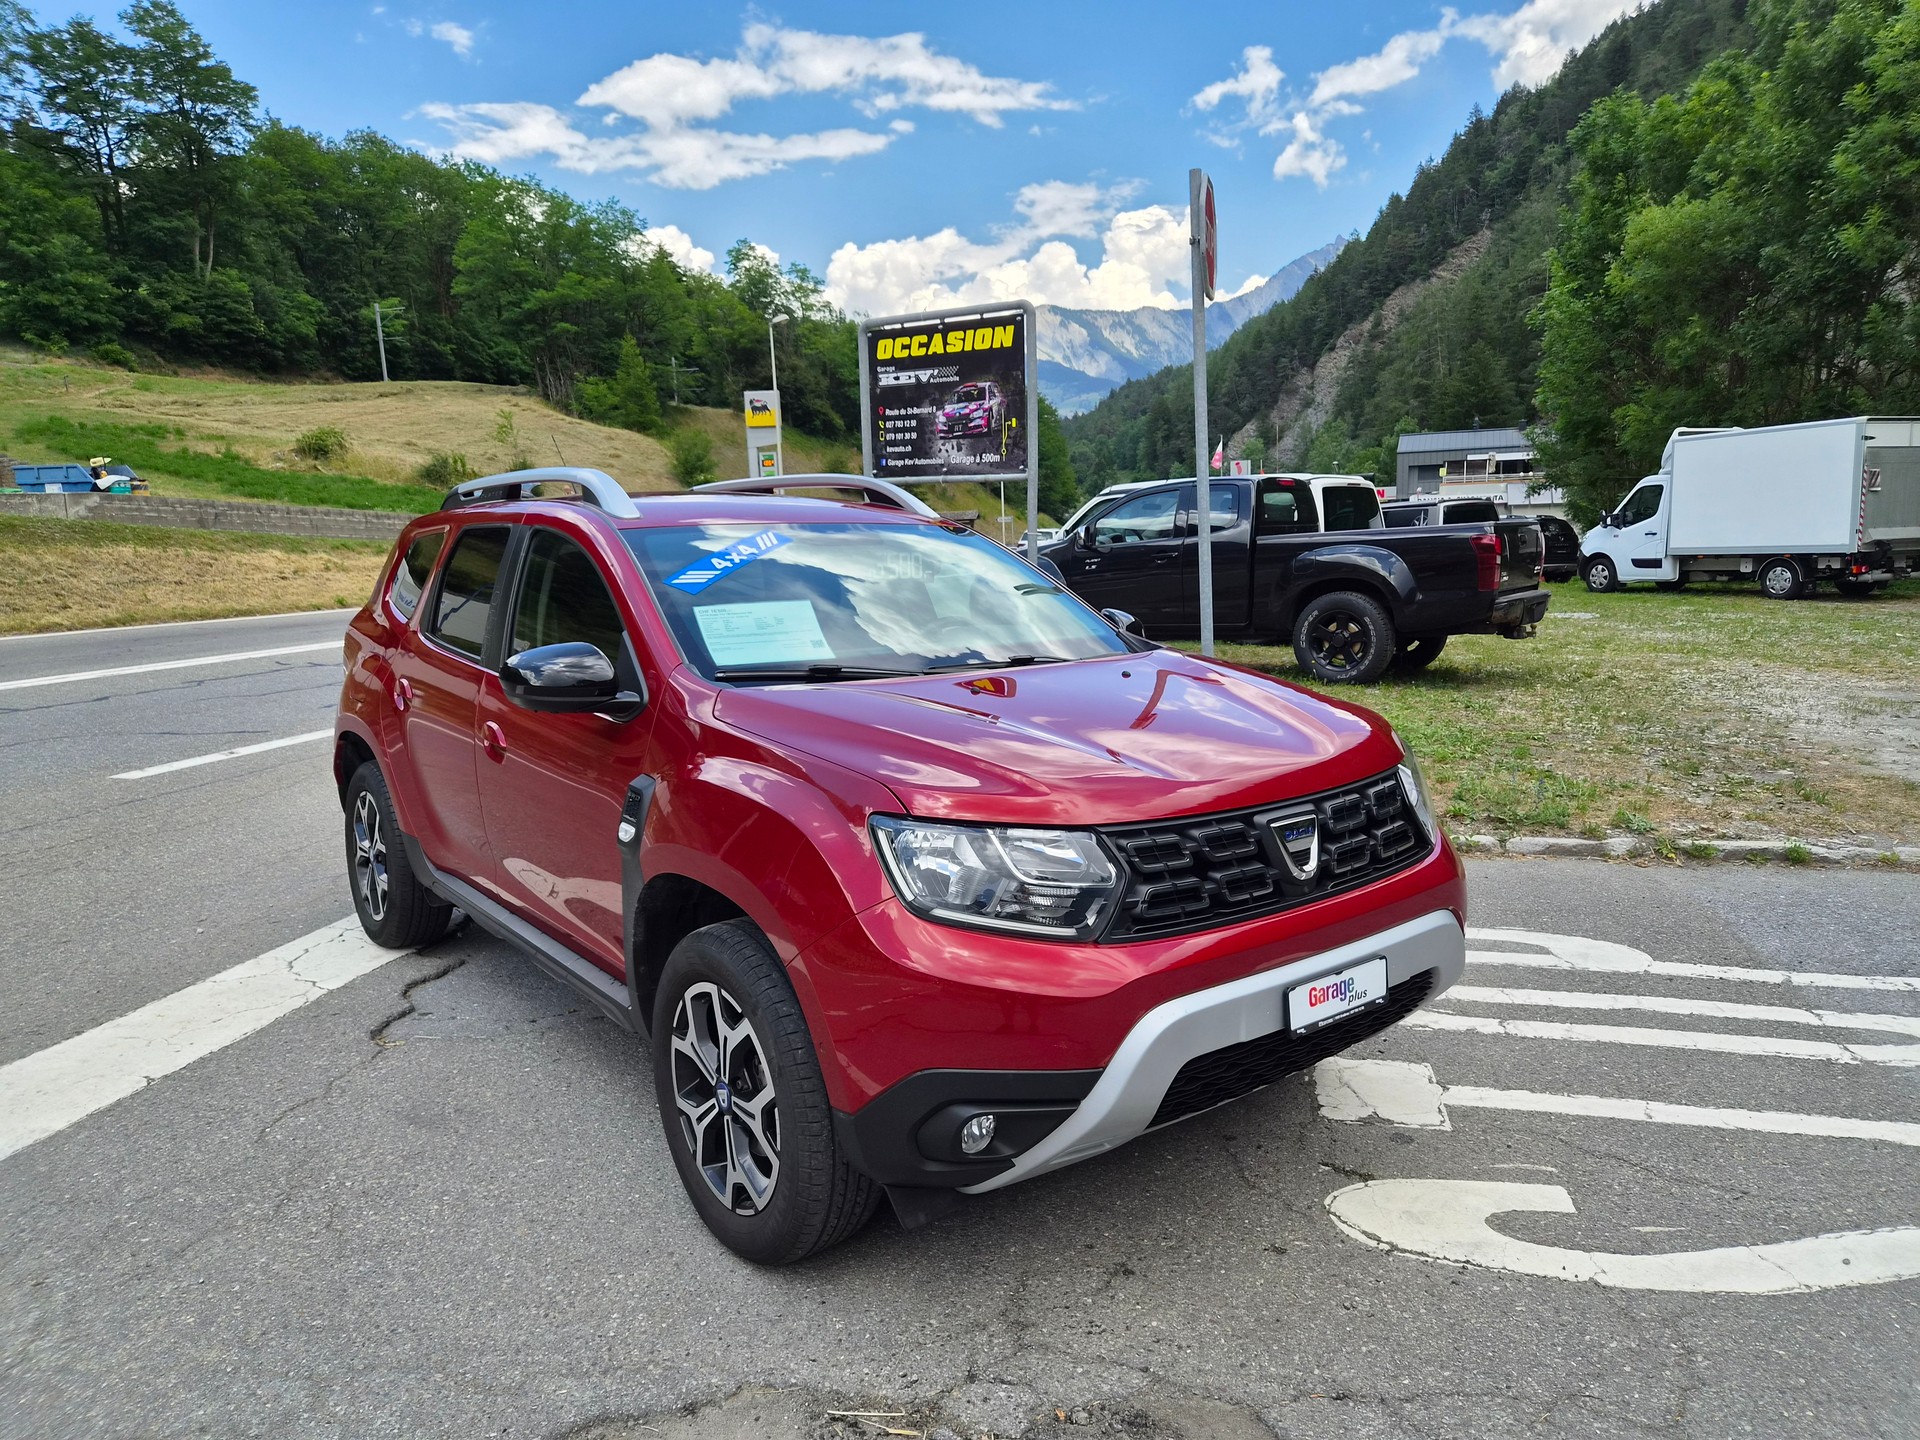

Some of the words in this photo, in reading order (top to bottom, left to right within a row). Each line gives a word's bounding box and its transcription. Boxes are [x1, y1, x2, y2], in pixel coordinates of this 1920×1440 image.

[876, 325, 1014, 360] OCCASION
[888, 459, 904, 467] Garage
[951, 455, 974, 465] Garage
[976, 453, 980, 462] à
[982, 453, 1000, 462] 500m
[710, 545, 759, 569] 4x4
[1308, 977, 1355, 1008] Garage
[1348, 989, 1368, 1006] plus
